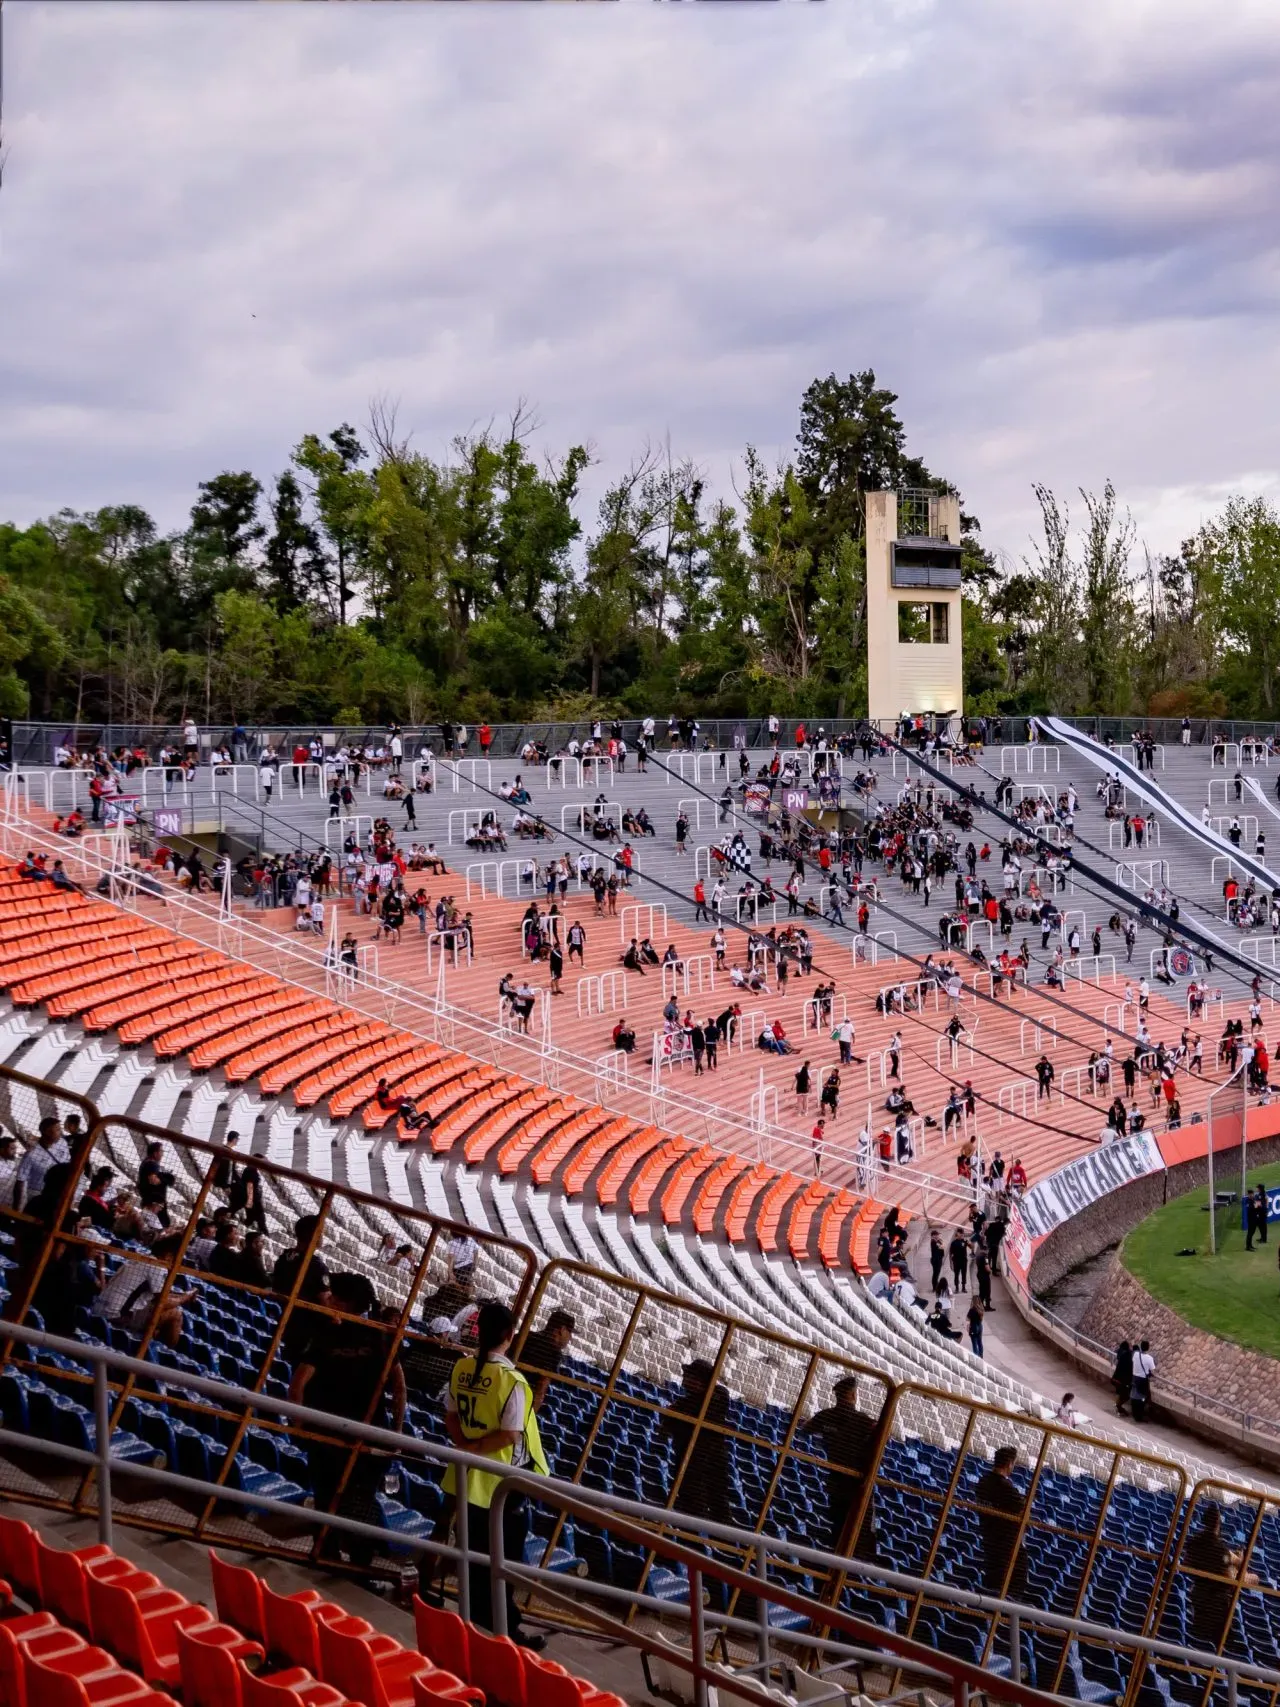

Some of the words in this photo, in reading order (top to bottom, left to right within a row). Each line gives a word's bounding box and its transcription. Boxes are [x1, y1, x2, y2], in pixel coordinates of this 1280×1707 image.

[787, 794, 804, 808] PN
[160, 813, 179, 832] PN
[1050, 1141, 1146, 1216] VISITANTE
[457, 1393, 487, 1430] RL
